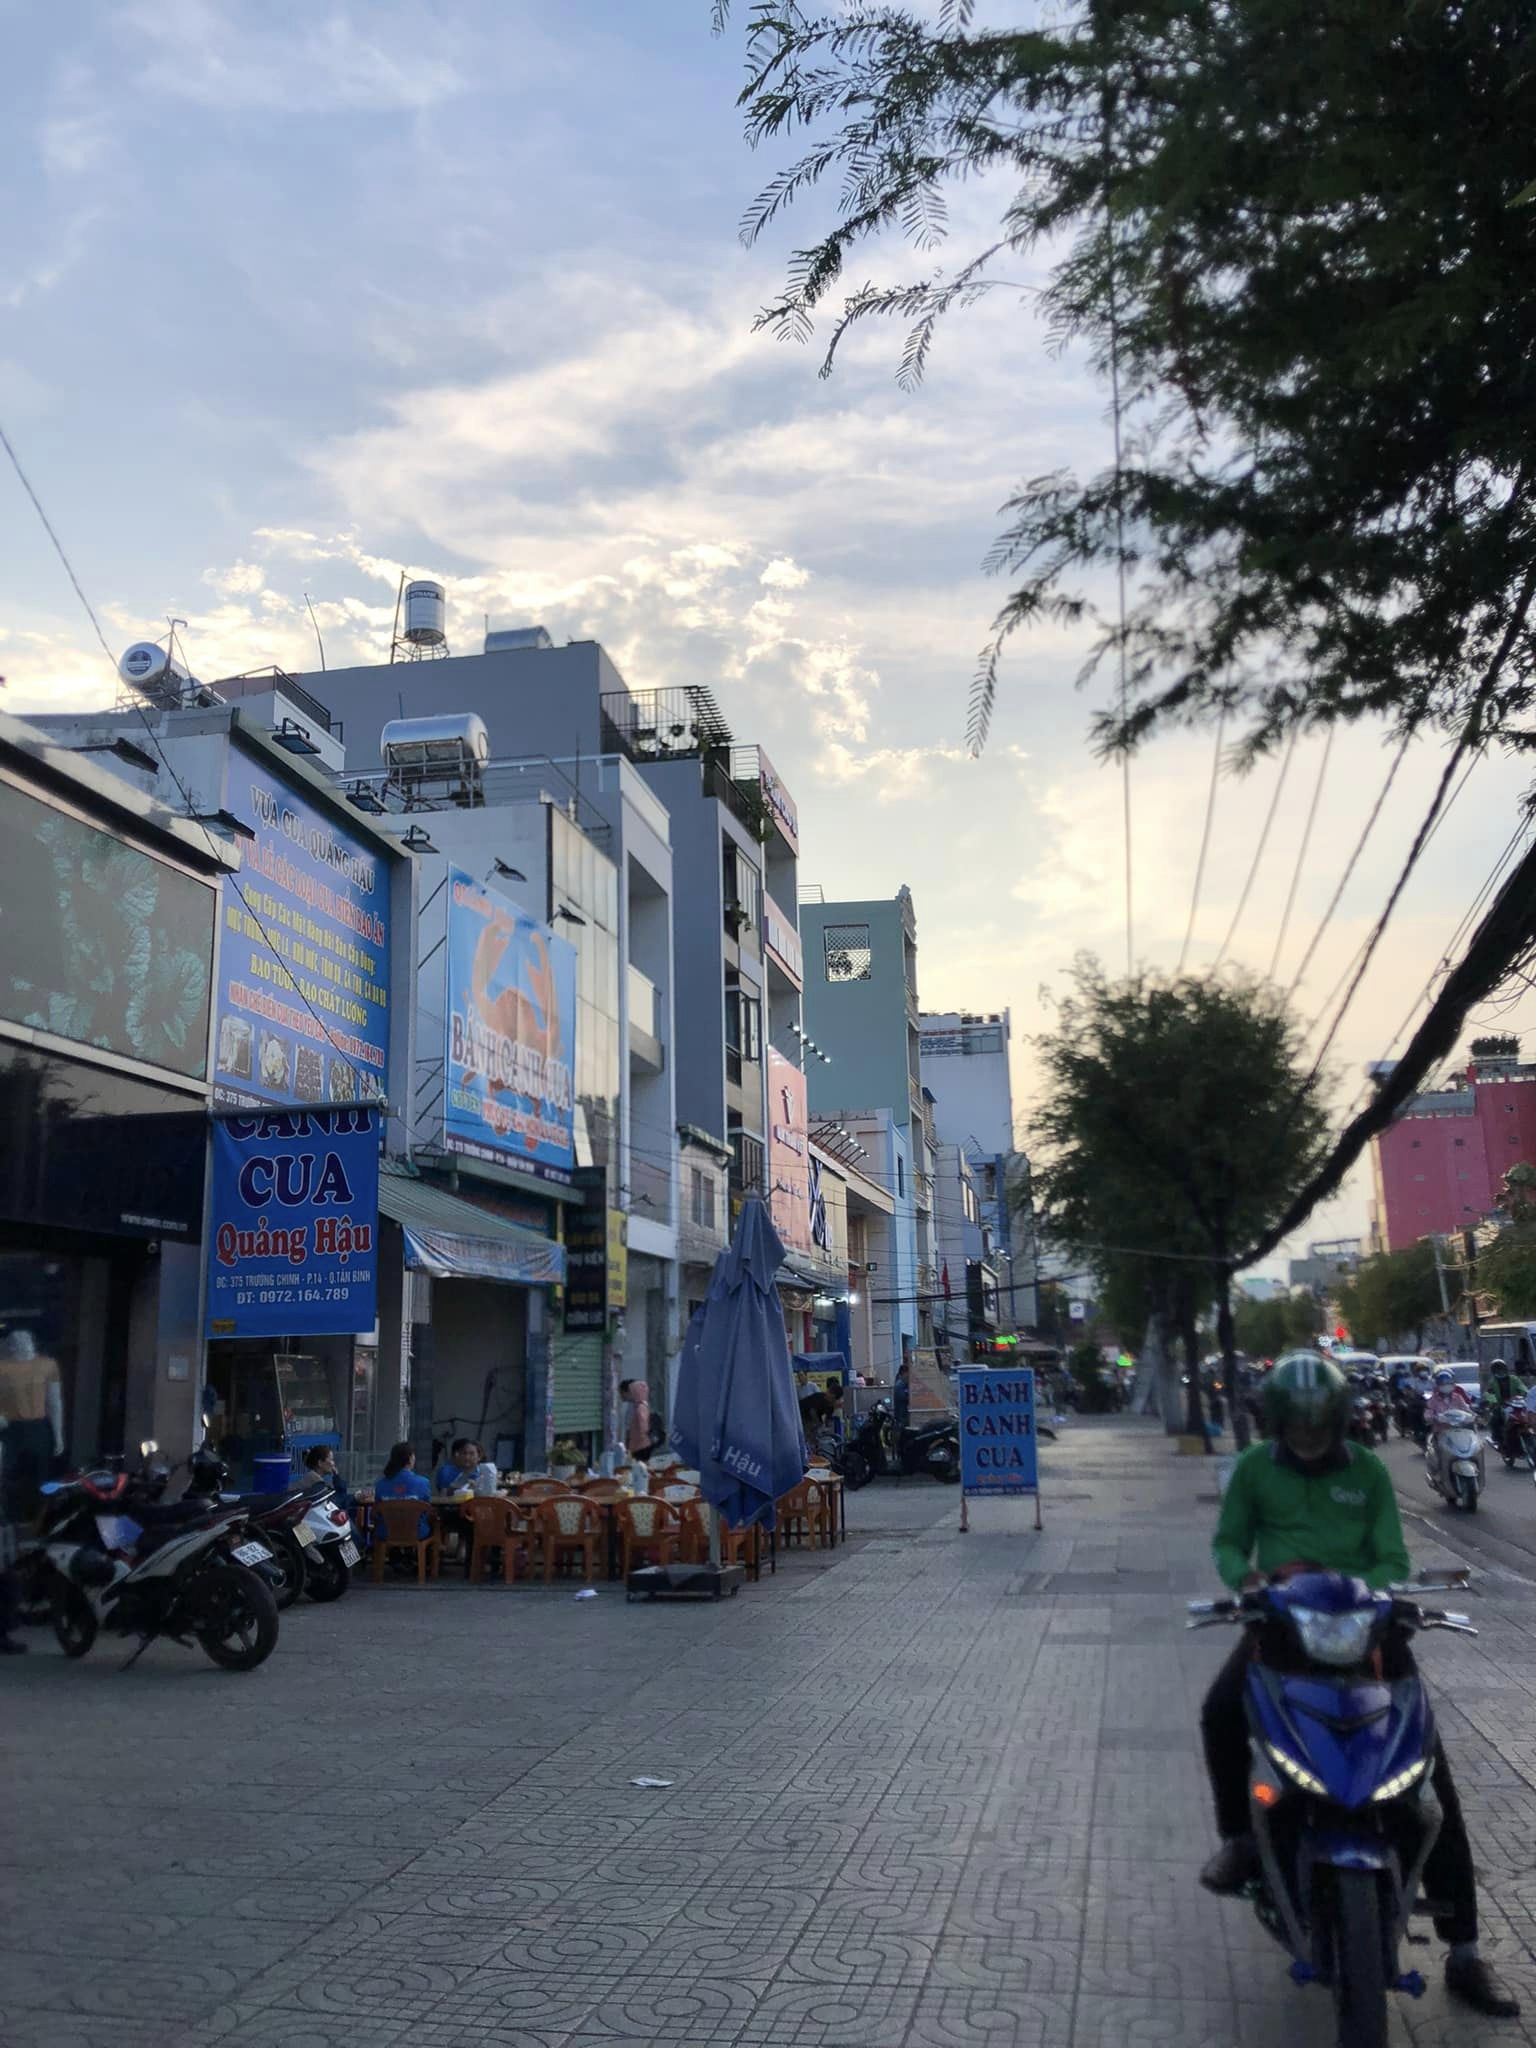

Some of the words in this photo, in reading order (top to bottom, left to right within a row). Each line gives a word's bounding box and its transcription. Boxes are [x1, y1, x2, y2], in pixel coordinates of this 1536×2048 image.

[251, 786, 280, 831] VỰA
[282, 808, 308, 850] CUA
[309, 828, 350, 877] QUẢNG
[350, 855, 375, 895] HẬU
[356, 906, 371, 941] BAO
[250, 953, 271, 979] BAO
[299, 975, 317, 1002] BAO
[318, 983, 340, 1014] CHẤT
[341, 996, 368, 1028] LƯỢNG
[239, 1152, 354, 1208] CUA
[216, 1216, 308, 1268] Quảng
[314, 1215, 373, 1264] Hậu
[230, 1275, 243, 1288] 375
[245, 1271, 275, 1288] TRƯỜNG
[276, 1273, 300, 1287] CHINH
[352, 1268, 371, 1283] BÌNH
[236, 1291, 256, 1305] ĐT:
[259, 1287, 349, 1303] 0972.164.789
[966, 1414, 1030, 1436] CANH
[723, 1445, 761, 1477] Hậu
[975, 1446, 1025, 1469] CUA
